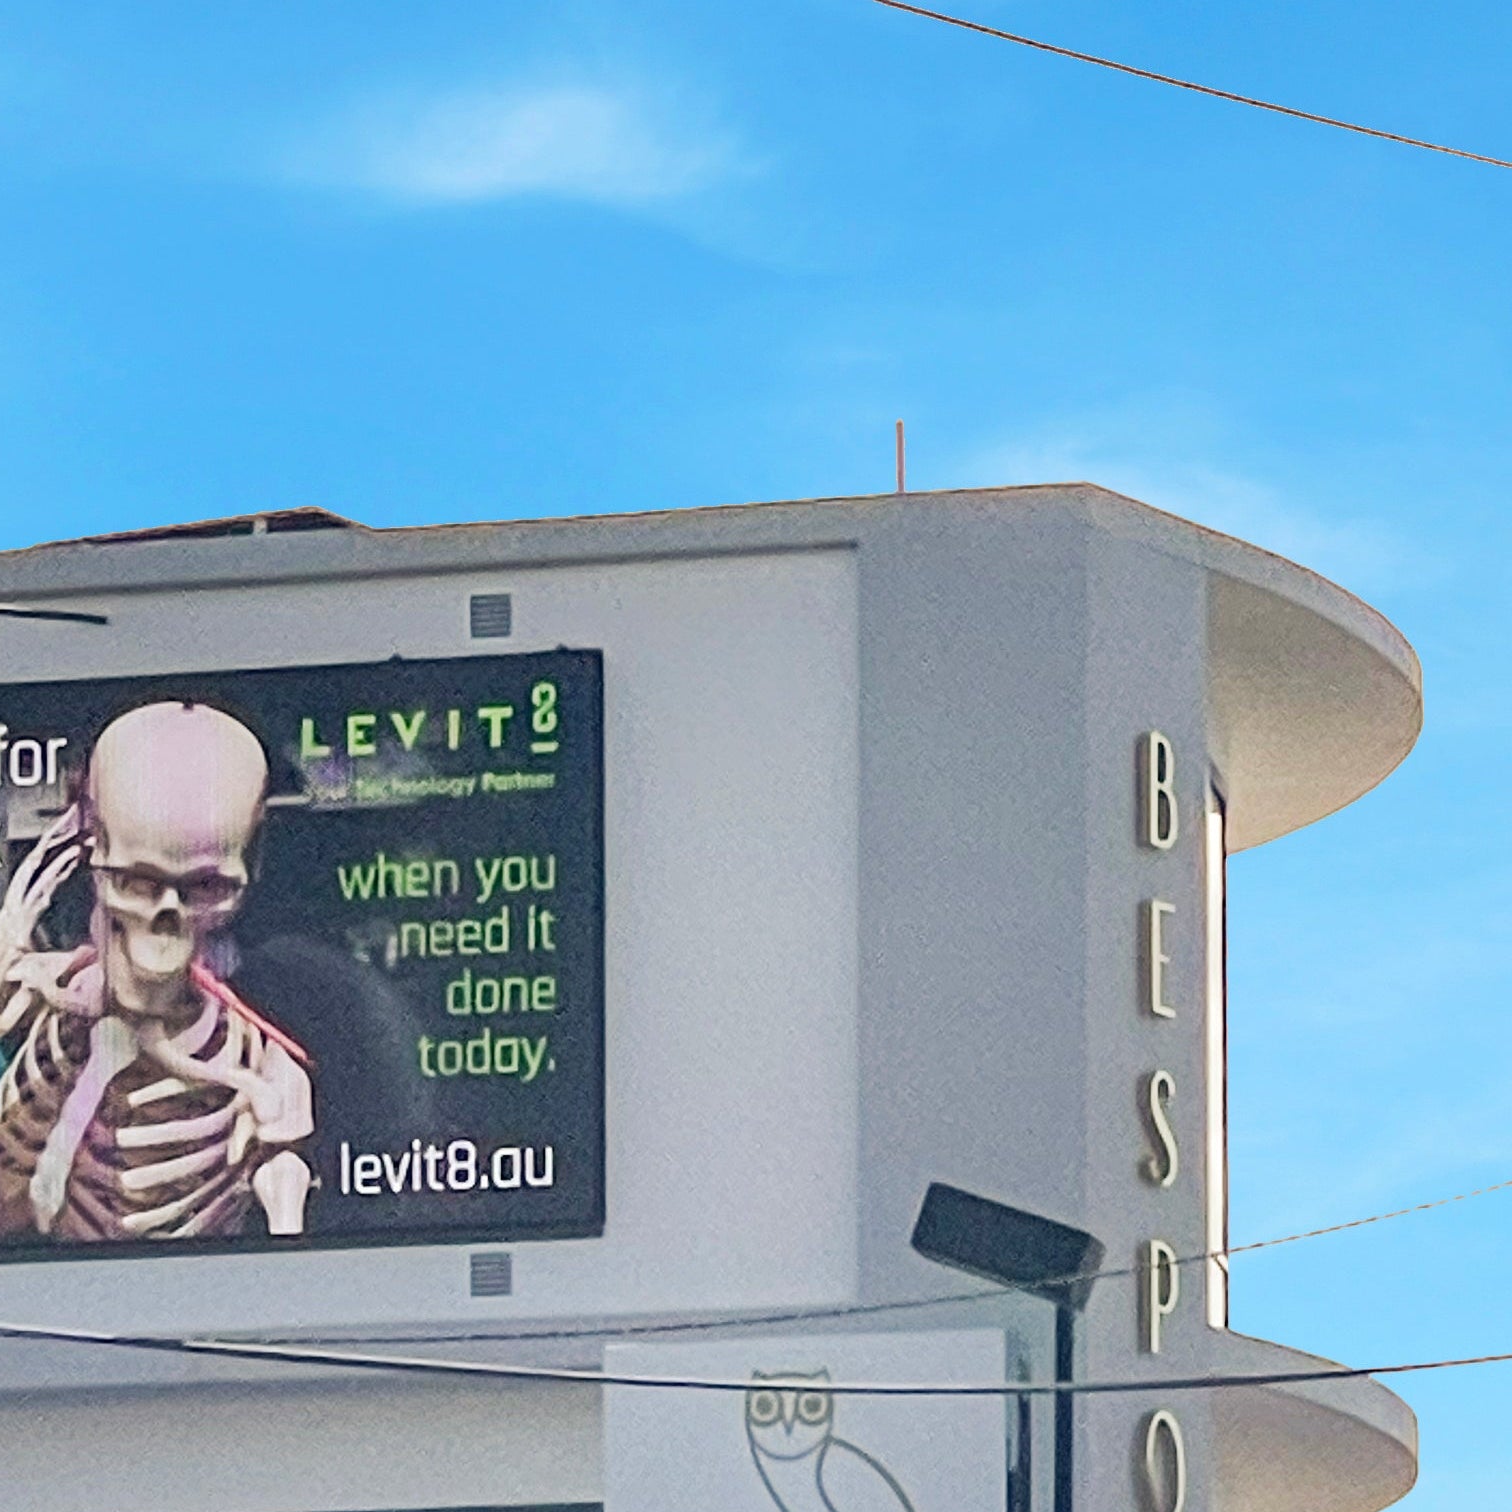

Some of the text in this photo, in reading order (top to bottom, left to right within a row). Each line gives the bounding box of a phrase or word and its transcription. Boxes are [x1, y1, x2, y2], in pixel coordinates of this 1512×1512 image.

[336, 853, 557, 904] when you
[396, 906, 557, 959] need it
[446, 969, 557, 1017] done
[418, 1028, 557, 1081] today.
[339, 1140, 555, 1196] levit8.au
